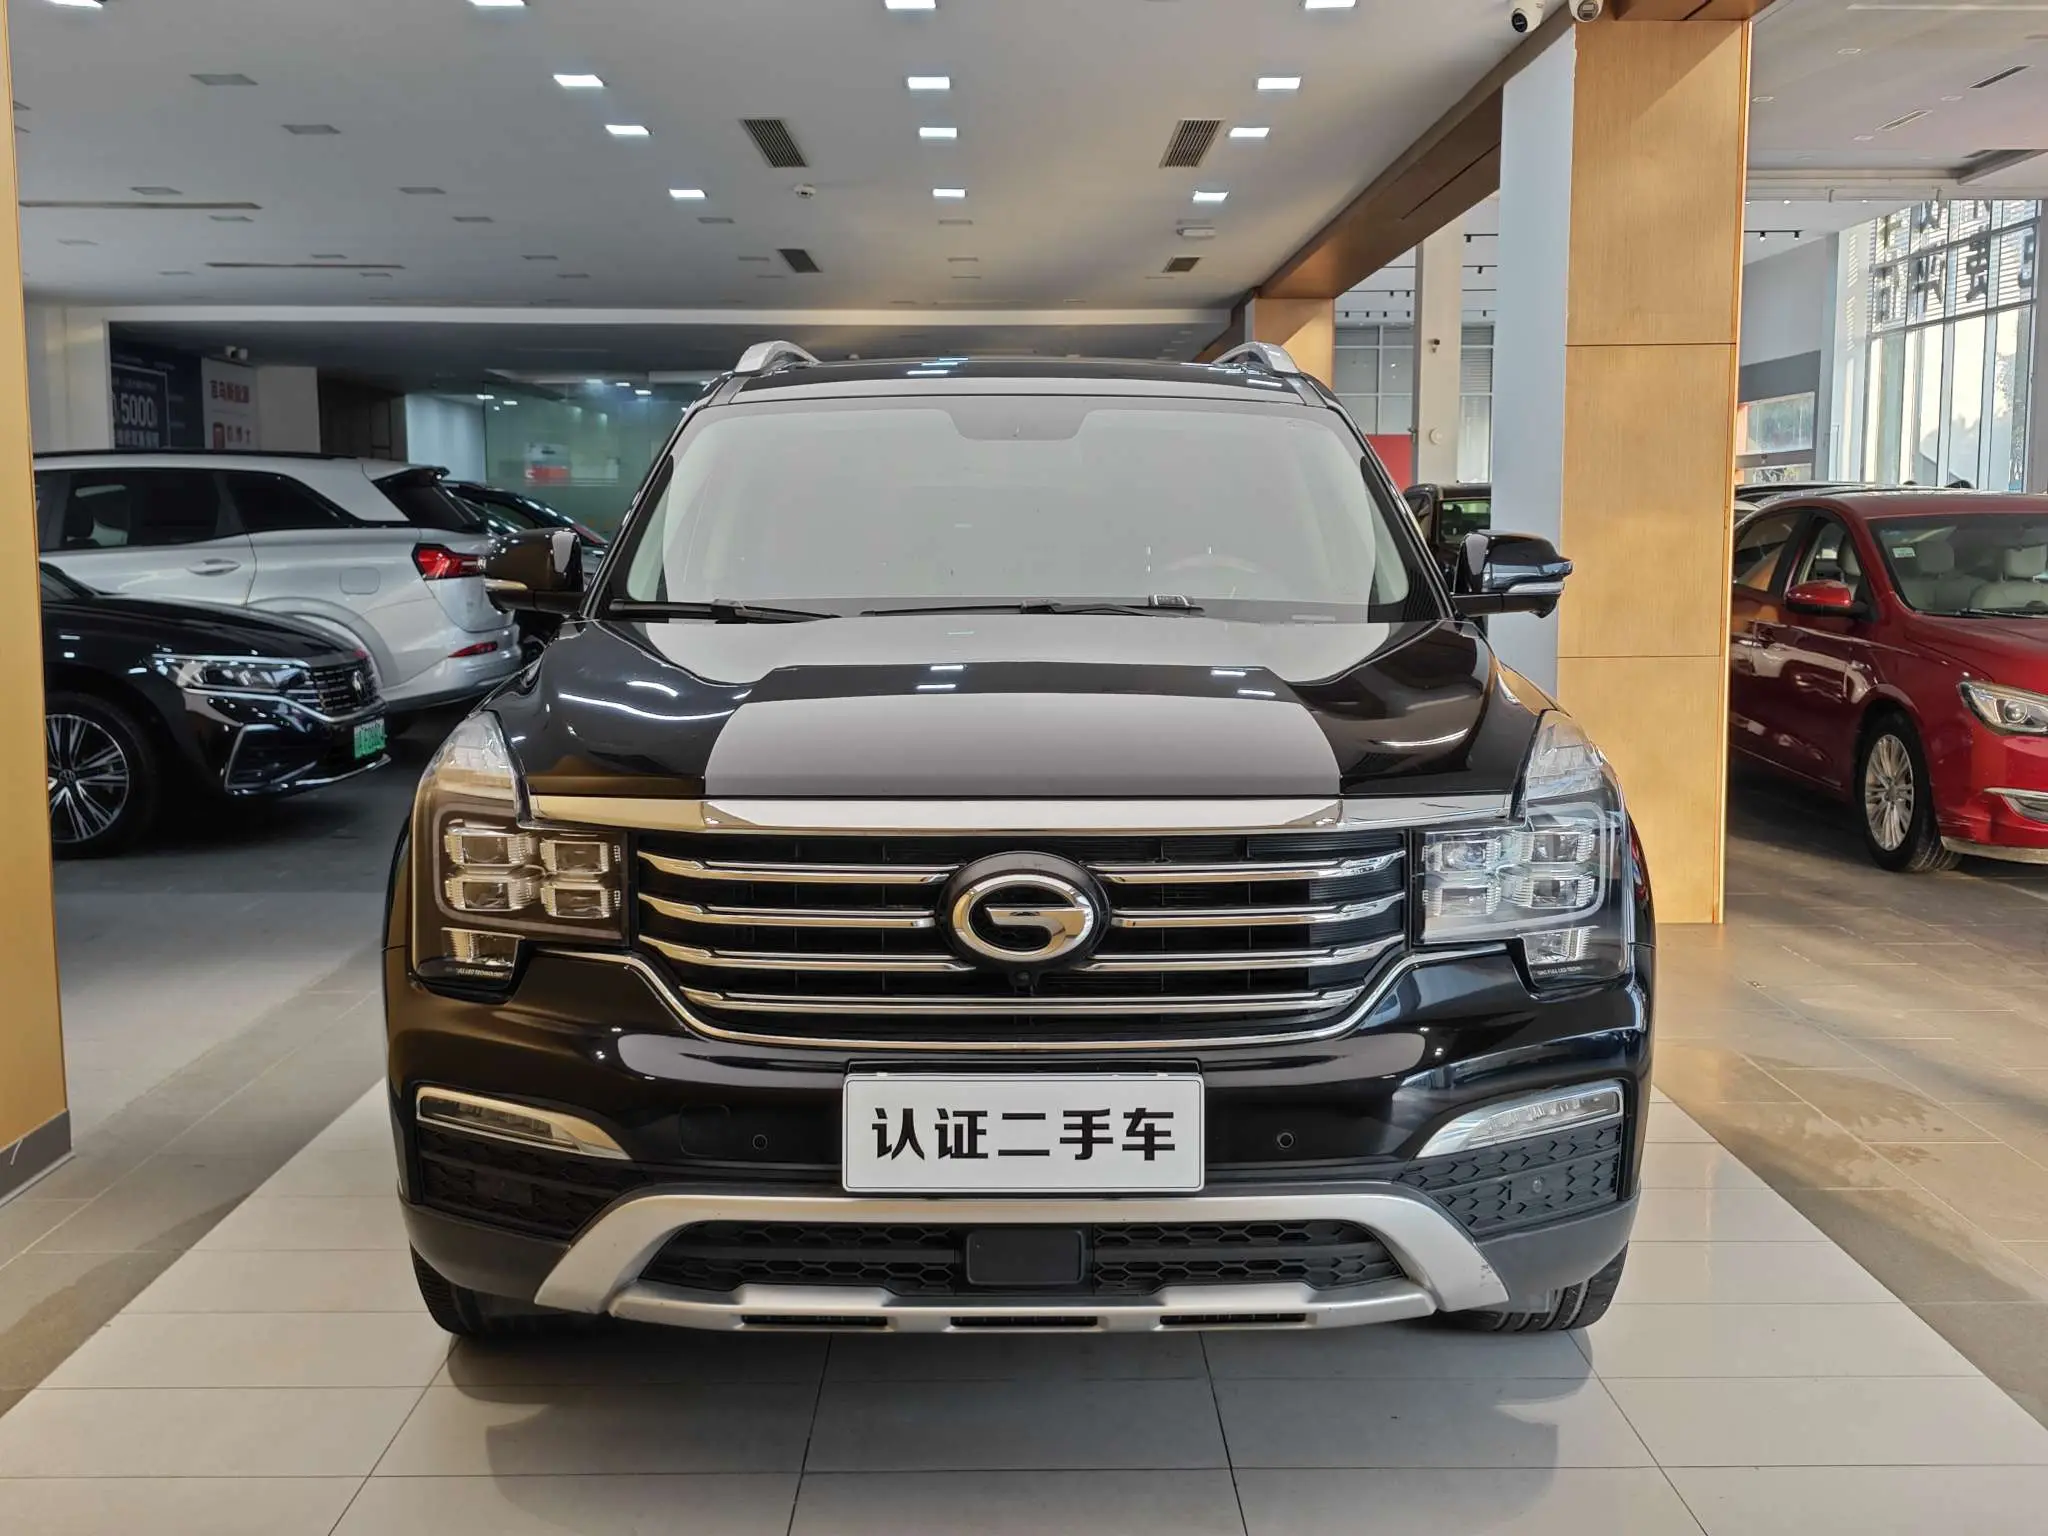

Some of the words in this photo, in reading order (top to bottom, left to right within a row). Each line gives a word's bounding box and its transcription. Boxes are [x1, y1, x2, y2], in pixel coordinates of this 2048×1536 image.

[872, 1107, 1175, 1161] 认证二手车
